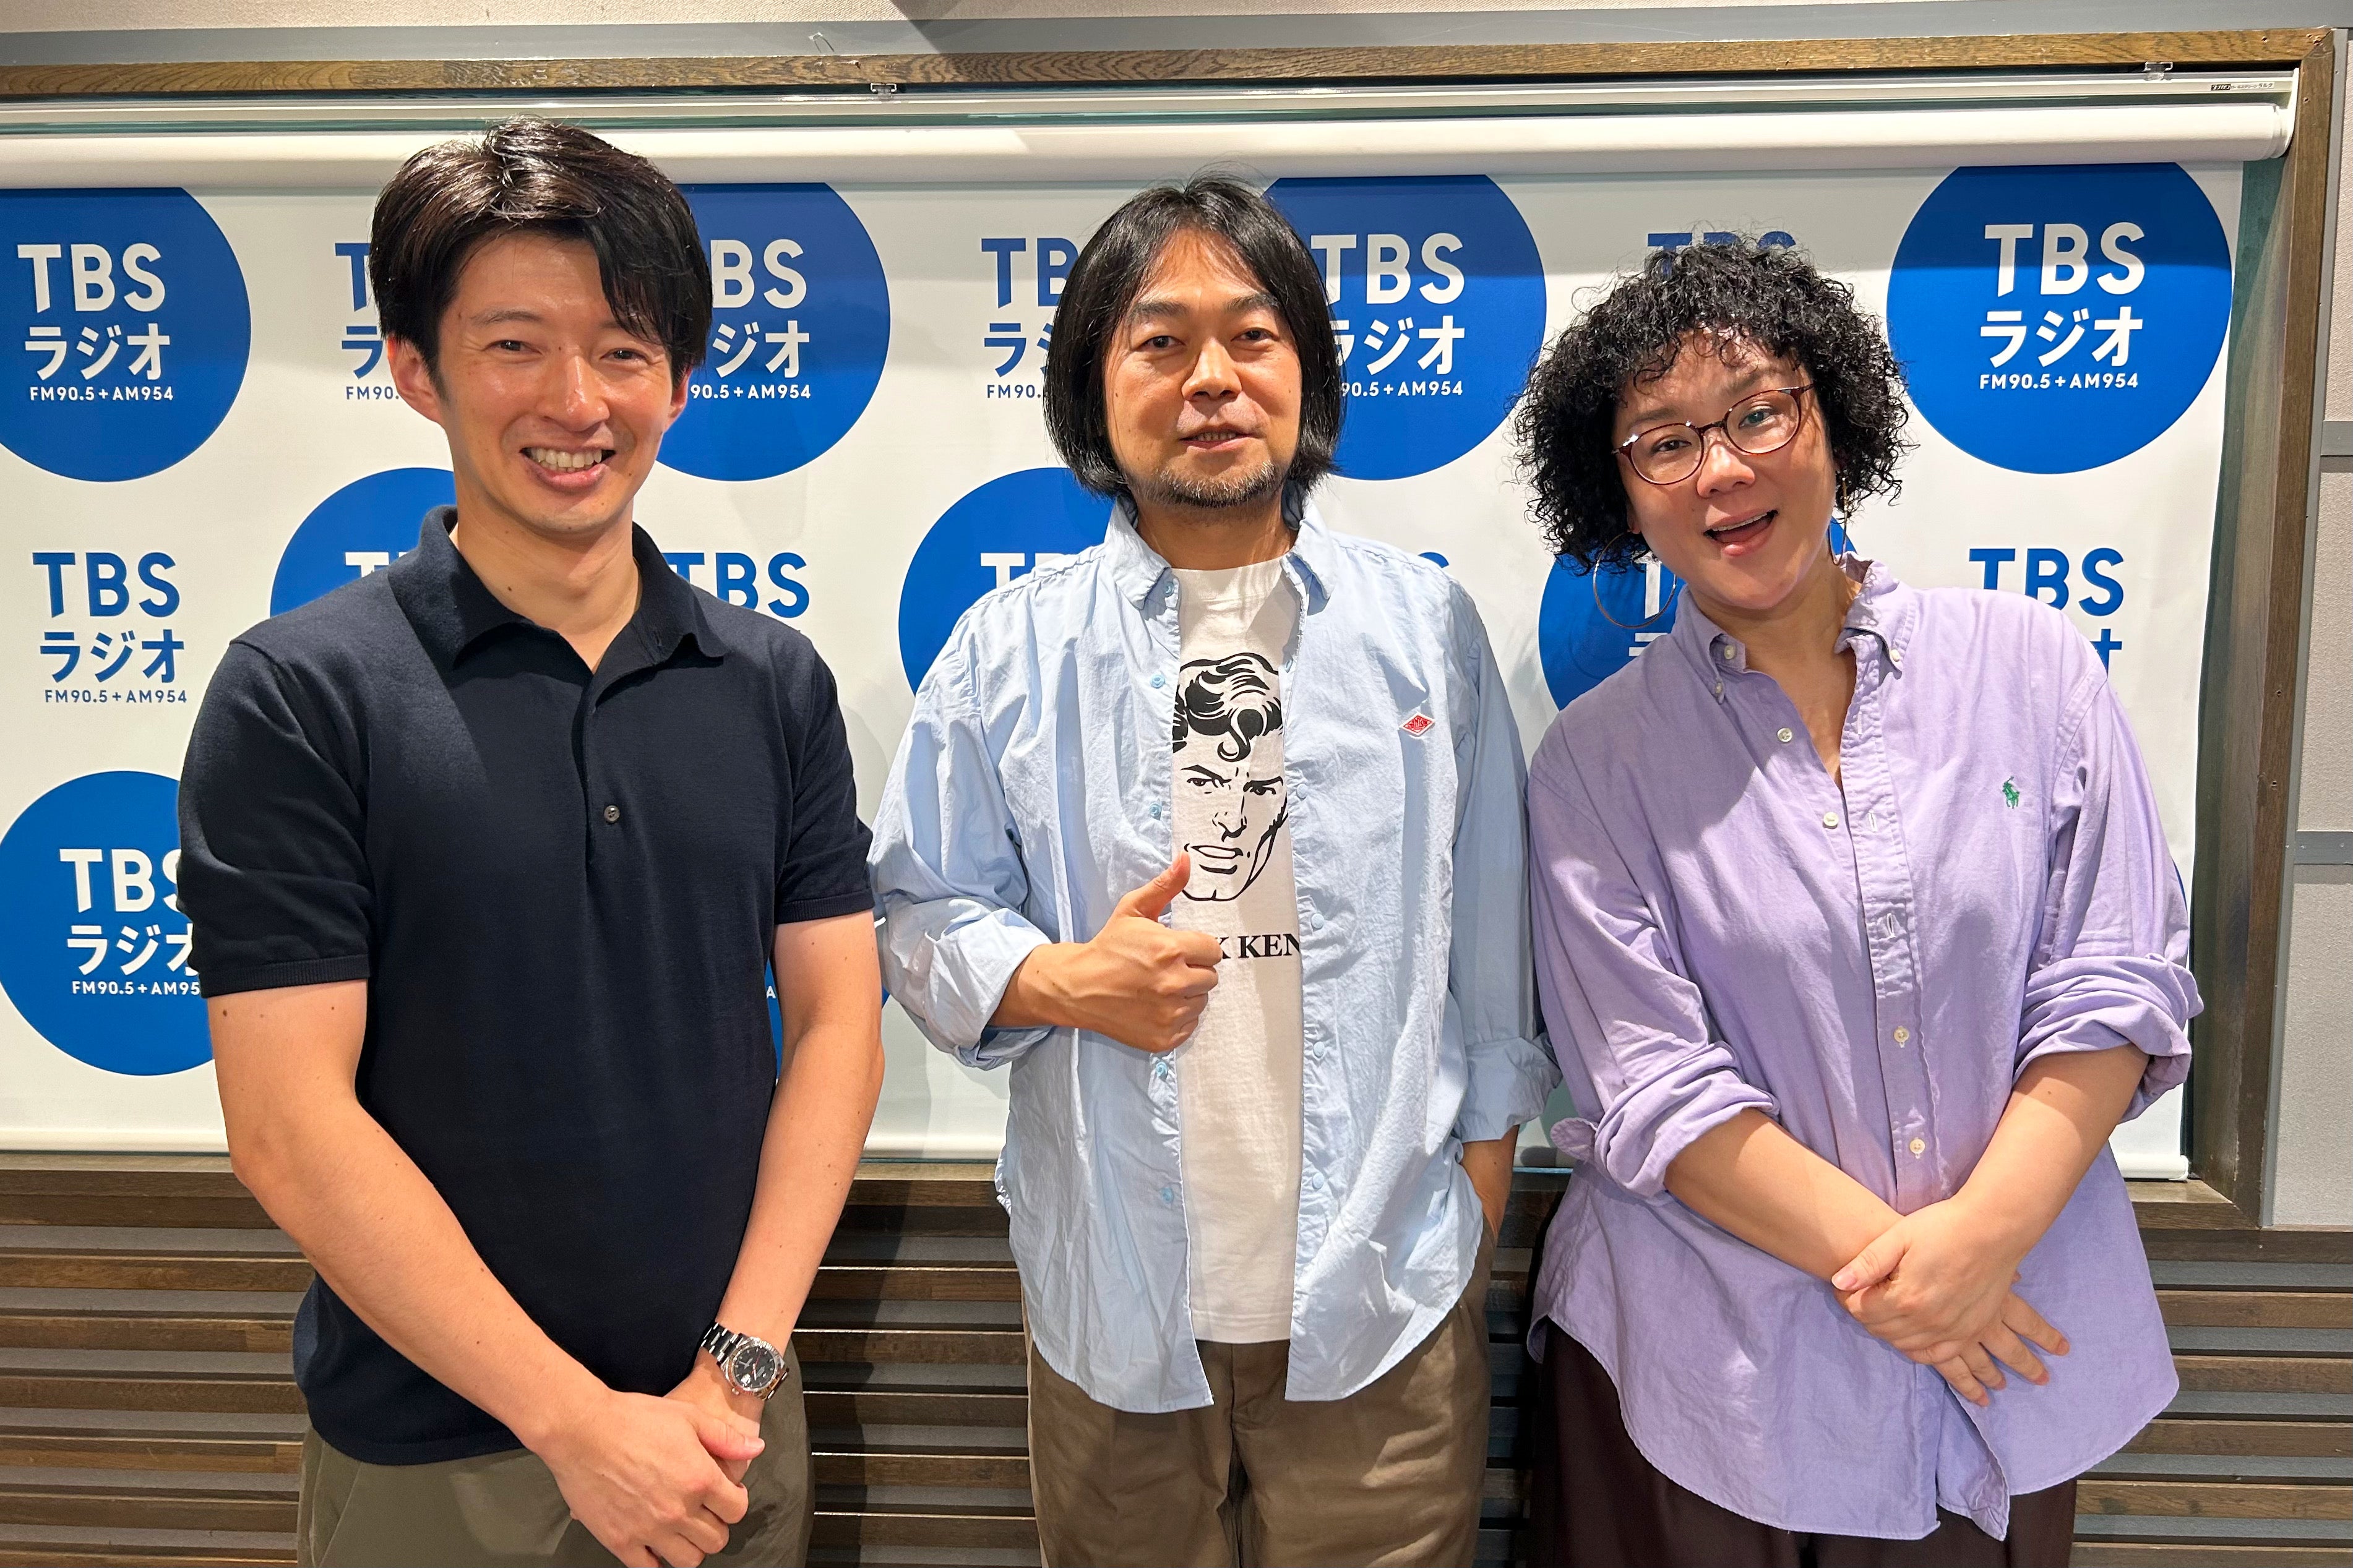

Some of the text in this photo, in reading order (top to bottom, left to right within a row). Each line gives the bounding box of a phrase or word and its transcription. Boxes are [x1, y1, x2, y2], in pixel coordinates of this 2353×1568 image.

[17, 242, 166, 313] TBS
[710, 239, 807, 309] BS
[981, 238, 1079, 309] TB
[1310, 233, 1465, 306] TBS
[1985, 221, 2145, 297] TBS
[25, 323, 170, 380] ラジオ
[712, 320, 810, 378] ジオ
[1981, 306, 2143, 367] ラジオ
[30, 386, 174, 401] FM90.5+AM954
[346, 386, 399, 400] FM90.
[690, 384, 811, 399] 90.5+AM954
[987, 384, 1041, 398] FM90.
[1979, 373, 2138, 389] FM90.5+AM954
[32, 552, 180, 617] TBS
[1969, 547, 2124, 616] TBS
[40, 629, 184, 683] ラジオ
[45, 689, 187, 703] FM90.5+AM954
[1237, 933, 1300, 958] KEN
[72, 981, 200, 995] FM90.5+AM95
